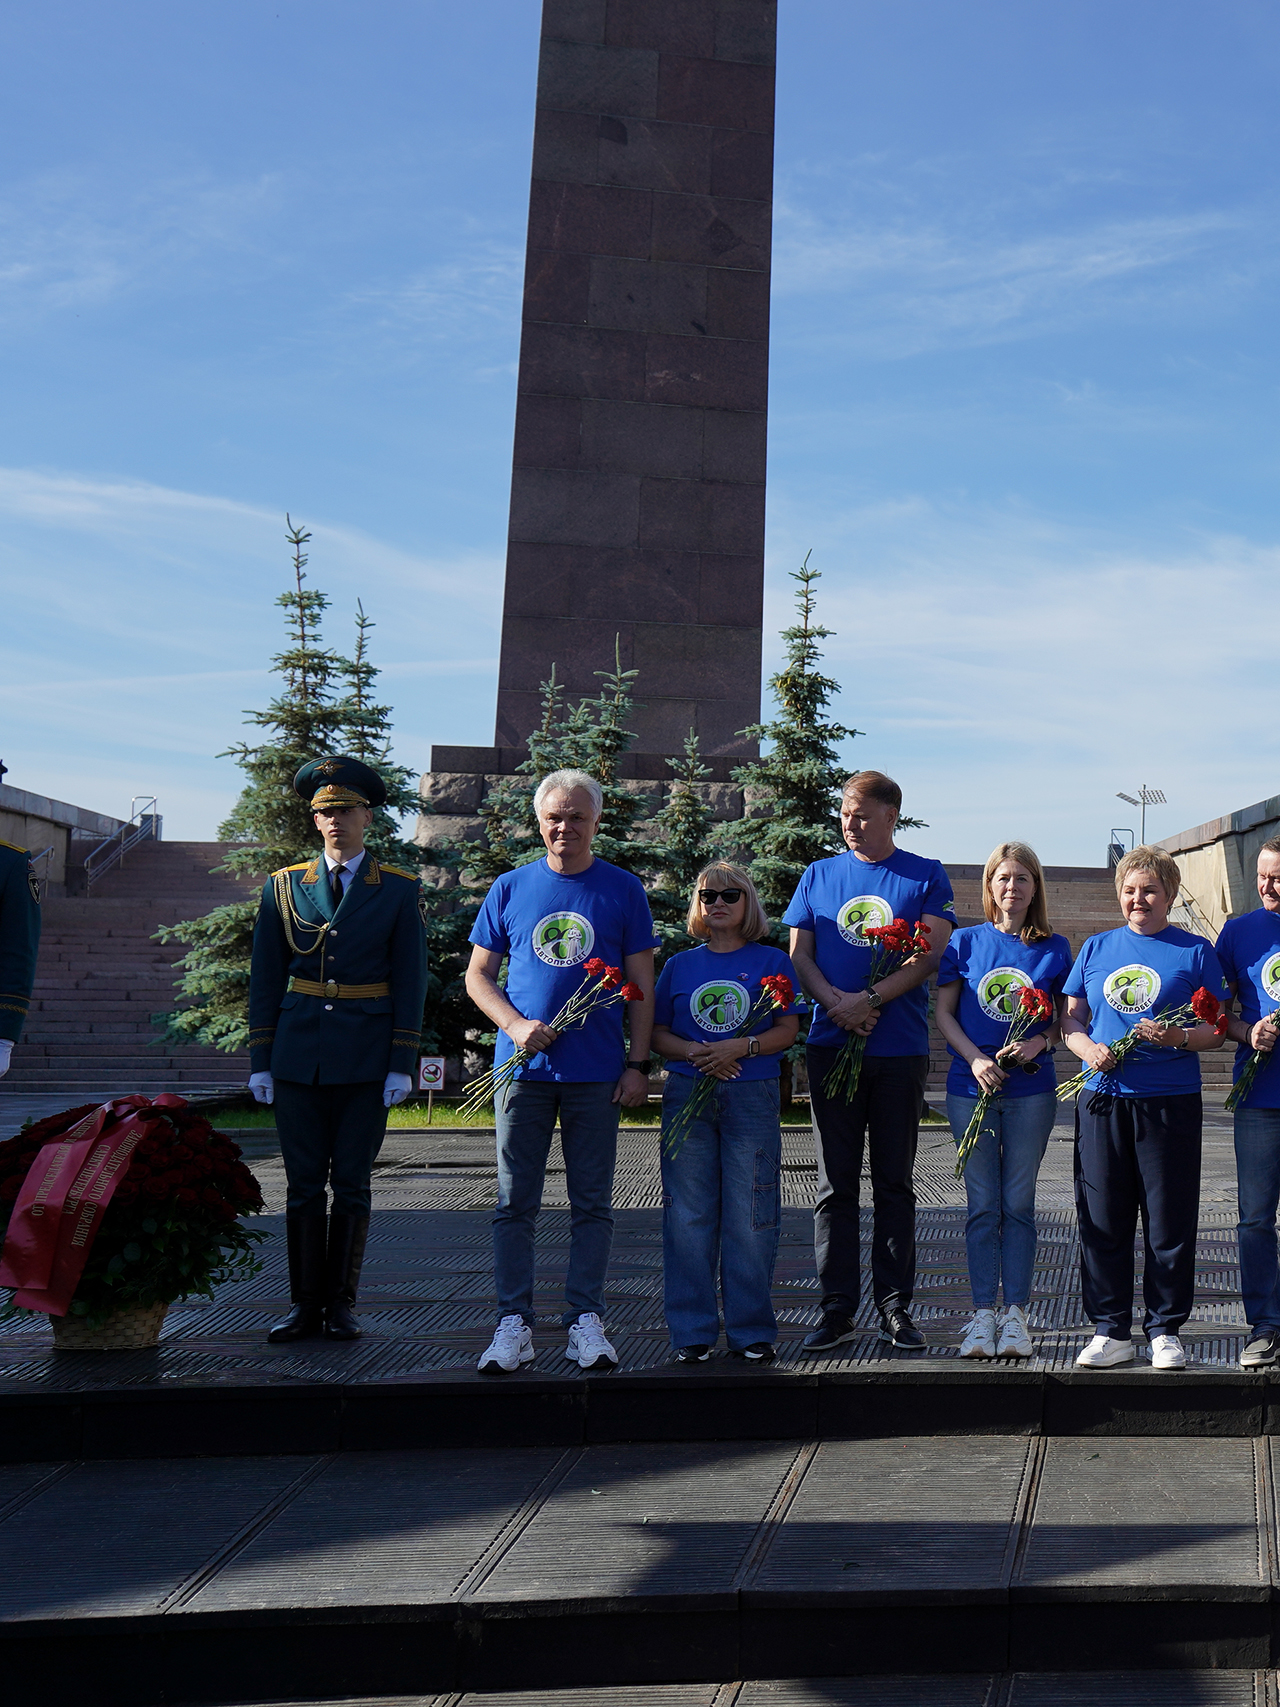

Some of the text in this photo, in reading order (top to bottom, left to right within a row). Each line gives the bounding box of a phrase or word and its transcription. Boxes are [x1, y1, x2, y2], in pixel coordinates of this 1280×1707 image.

[535, 947, 586, 965] АВТОПРОБЕГ
[1106, 993, 1153, 1012] АВТОПРОБЕГ
[694, 1014, 744, 1031] АВТОПРОБЕГ
[62, 1144, 111, 1215] САНКТ-ПЕТЕРБУРГА
[71, 1129, 143, 1248] ЗАКОНОДАТЕЛЬНОГО СОБРАНИЯ
[31, 1203, 45, 1216] ОТ
